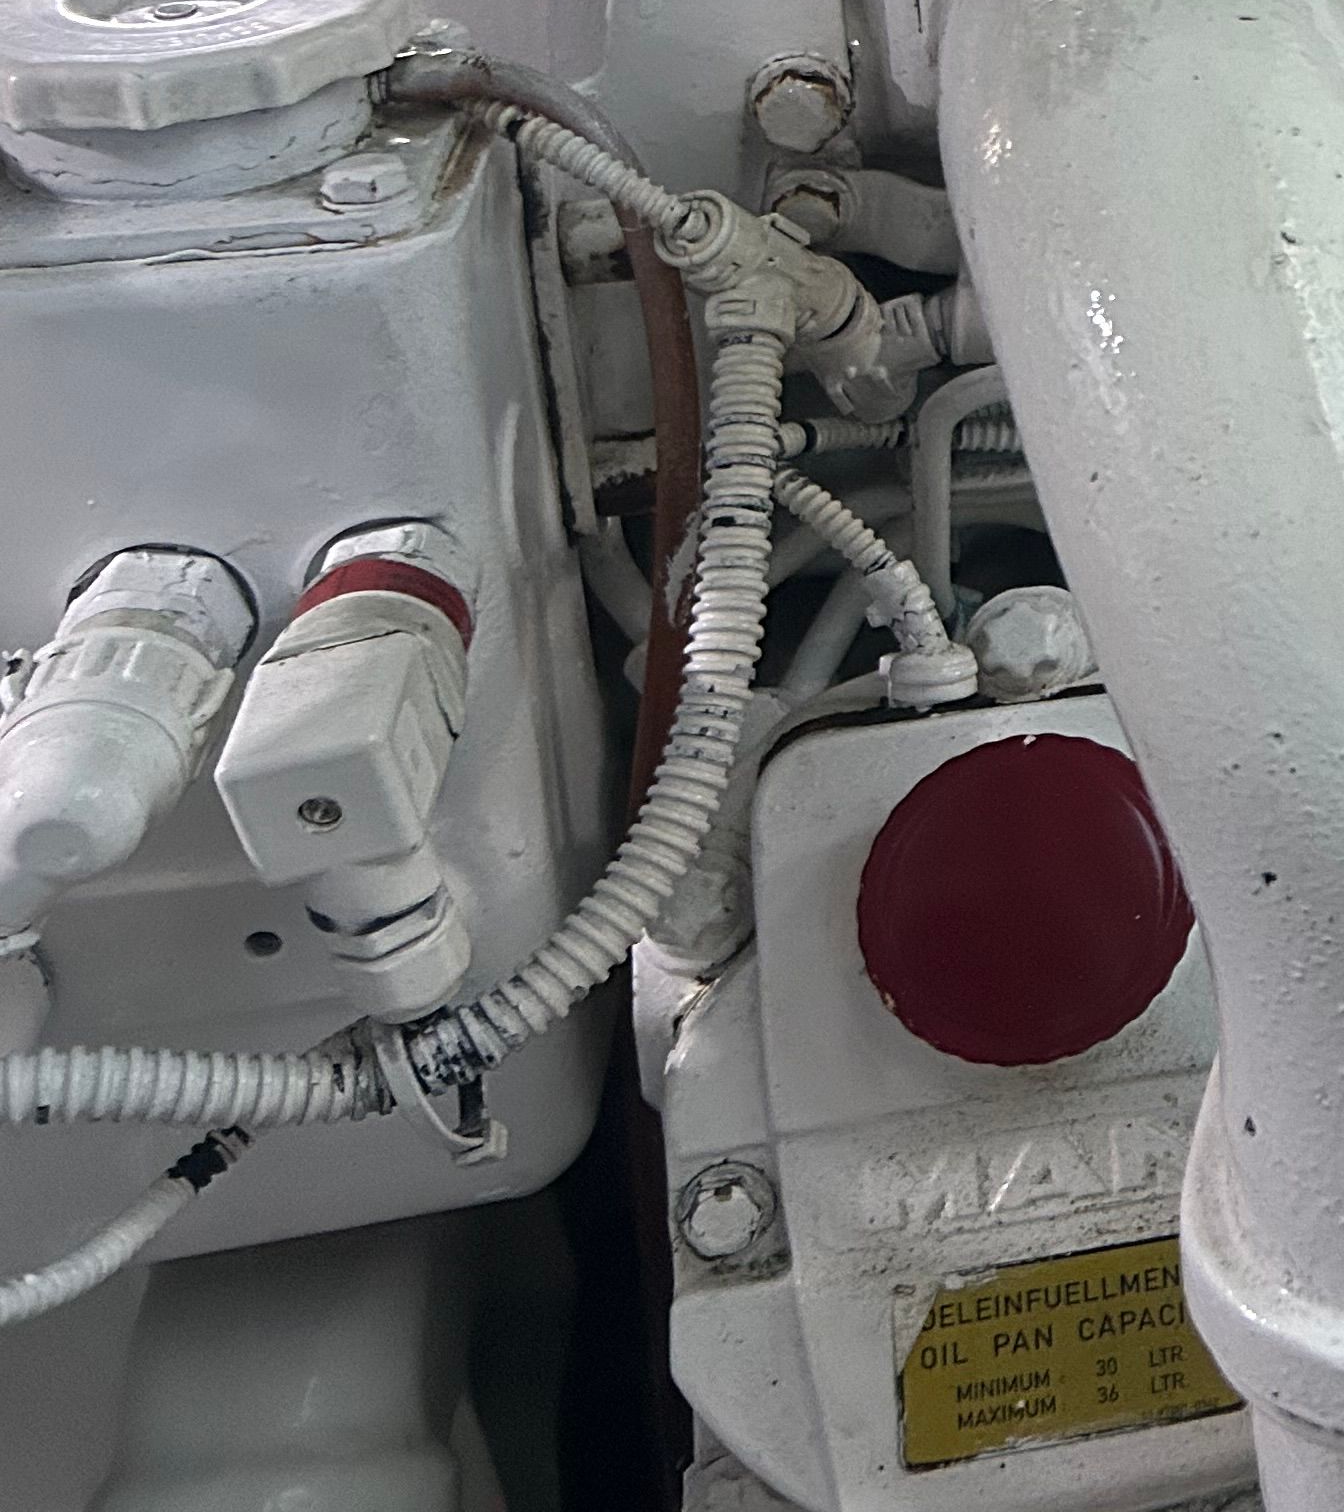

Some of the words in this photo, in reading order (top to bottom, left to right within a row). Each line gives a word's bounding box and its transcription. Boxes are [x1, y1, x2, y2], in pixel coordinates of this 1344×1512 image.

[920, 1340, 969, 1370] OIL
[993, 1324, 1053, 1358] PAN
[1078, 1300, 1185, 1341] CAPACI
[956, 1369, 1051, 1403] MINIMUM
[1095, 1356, 1118, 1377] 30
[957, 1396, 1057, 1431] MAXIMUM
[1097, 1385, 1119, 1405] 36
